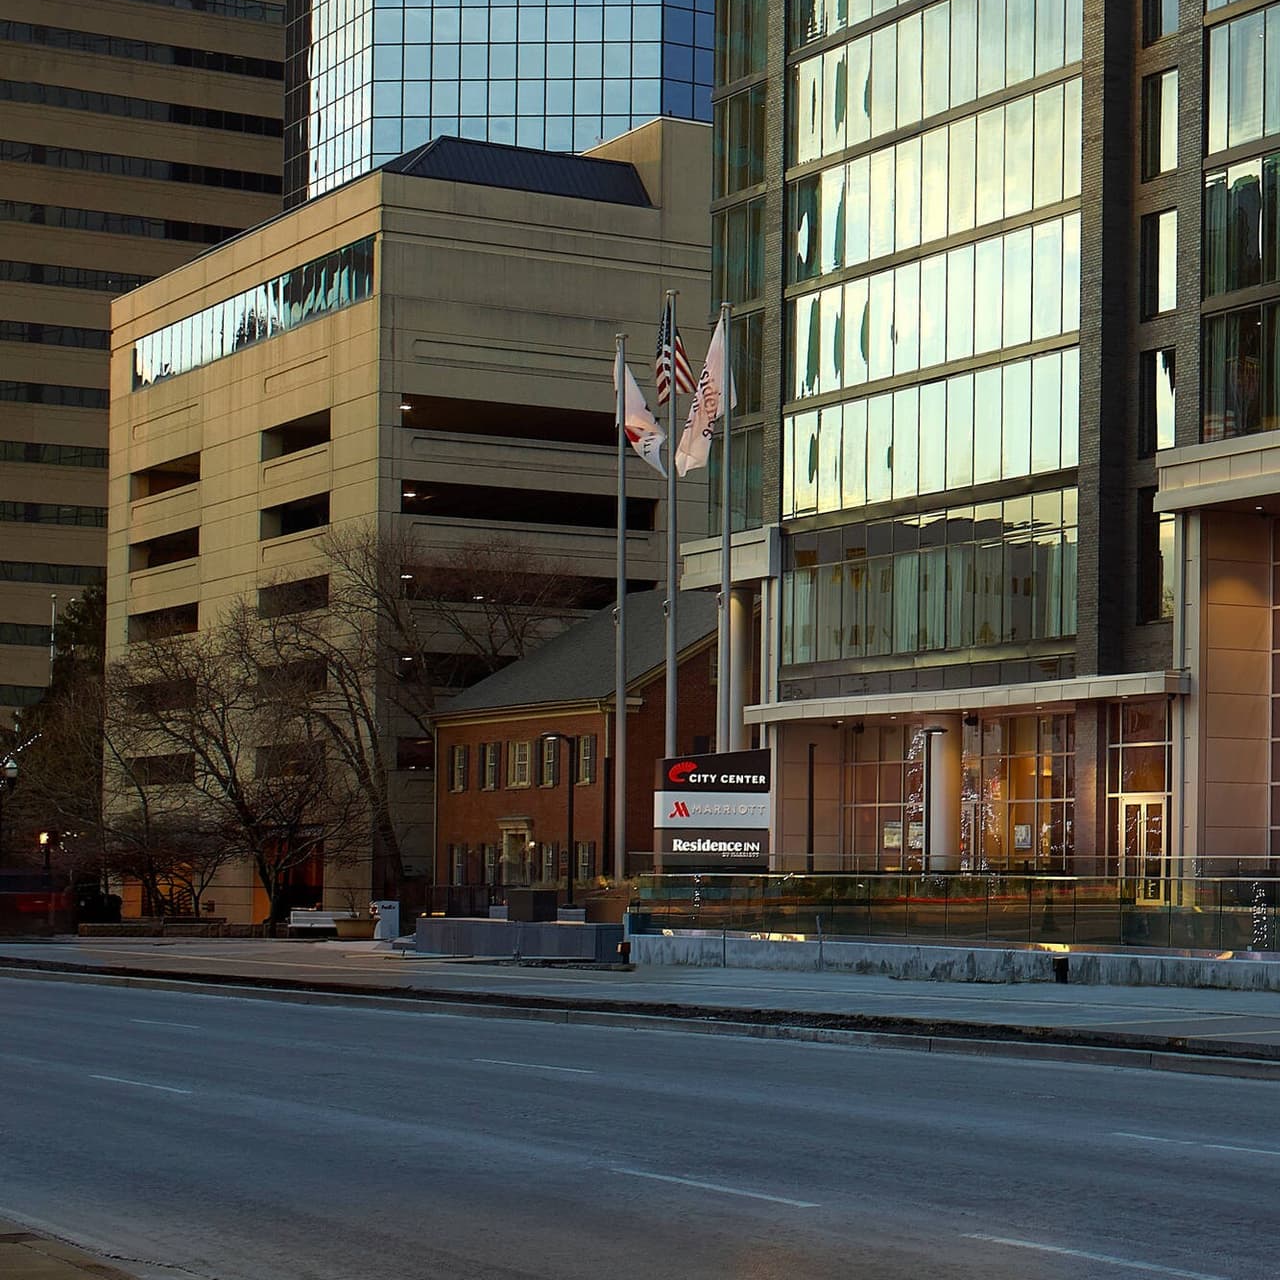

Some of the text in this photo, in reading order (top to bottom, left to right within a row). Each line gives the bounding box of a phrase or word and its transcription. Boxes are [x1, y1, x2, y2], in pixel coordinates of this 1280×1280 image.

[689, 774, 766, 784] CITY CENTER
[692, 804, 766, 816] MARRIOTT
[672, 838, 760, 852] Residence INN
